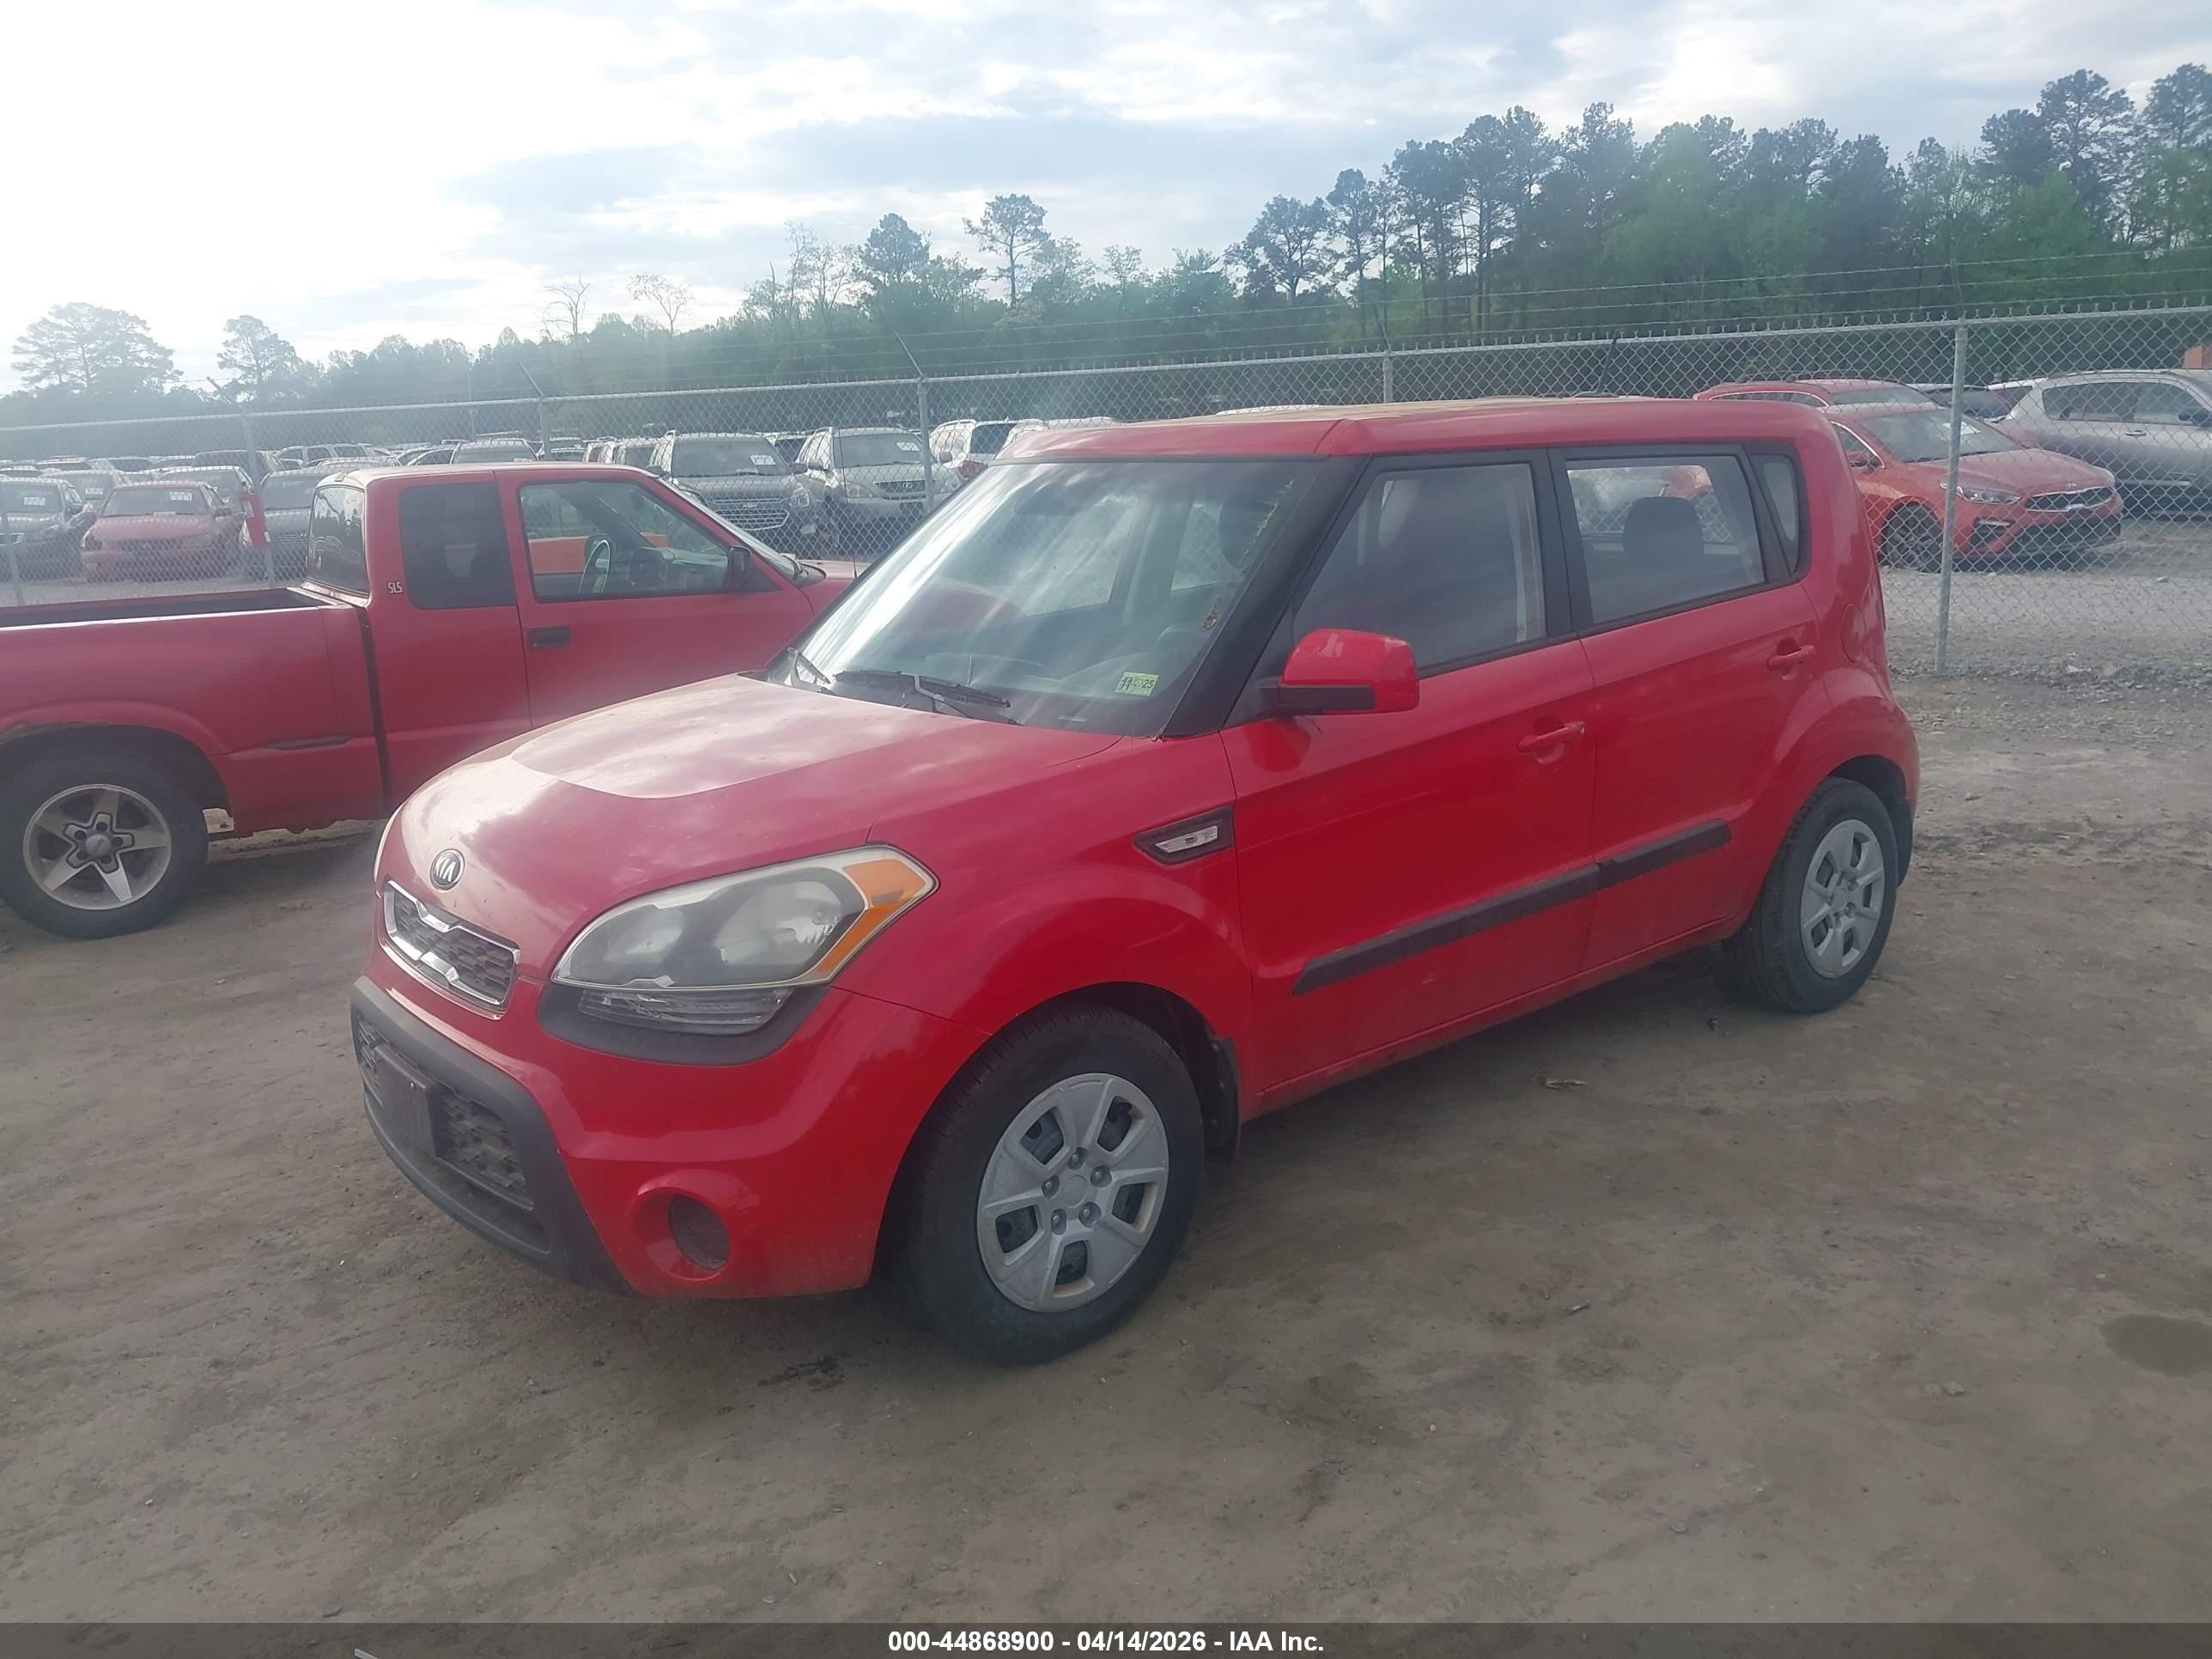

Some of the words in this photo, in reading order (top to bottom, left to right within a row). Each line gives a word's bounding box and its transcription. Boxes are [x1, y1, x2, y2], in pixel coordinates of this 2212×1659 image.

[387, 581, 403, 593] SLS
[1141, 678, 1155, 689] 25
[435, 855, 456, 883] KIA
